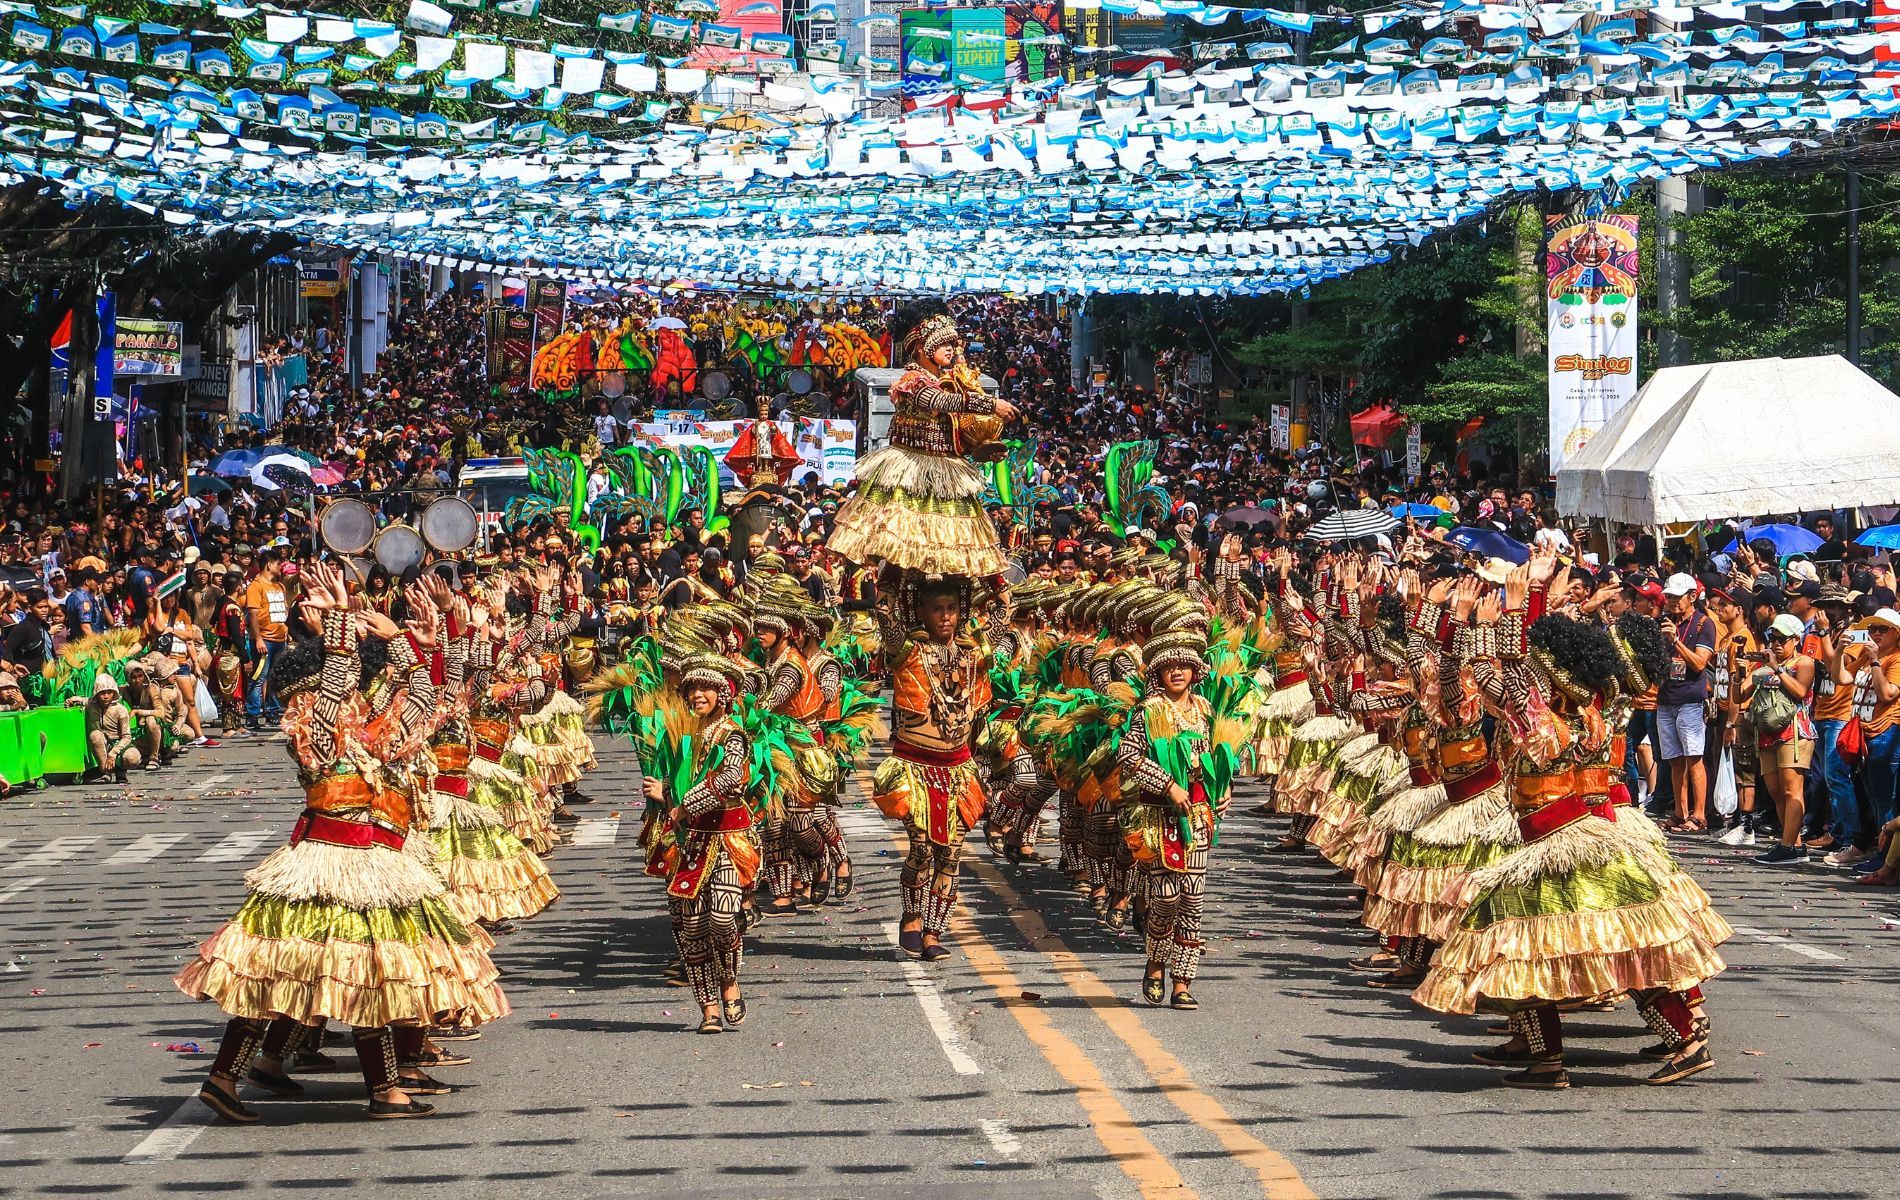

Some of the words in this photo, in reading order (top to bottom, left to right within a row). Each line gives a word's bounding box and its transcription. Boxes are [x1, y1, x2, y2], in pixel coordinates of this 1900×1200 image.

[19, 31, 44, 42] Smart
[67, 40, 89, 49] Smart
[109, 45, 133, 54] Smart
[161, 53, 184, 61] Smart
[957, 50, 999, 66] EXPERT
[204, 60, 226, 68] Smart
[254, 65, 280, 73] Smart
[1737, 74, 1759, 88] Smart
[285, 110, 306, 119] Smart
[330, 113, 354, 121] Smart
[375, 119, 397, 128] Smart
[419, 122, 443, 131] Smart
[300, 271, 318, 279] ATM
[115, 333, 178, 349] PAKALS
[1554, 353, 1632, 376] Sinulog
[200, 365, 228, 379] ONEY
[188, 383, 227, 397] CHANGER
[95, 398, 107, 411] S
